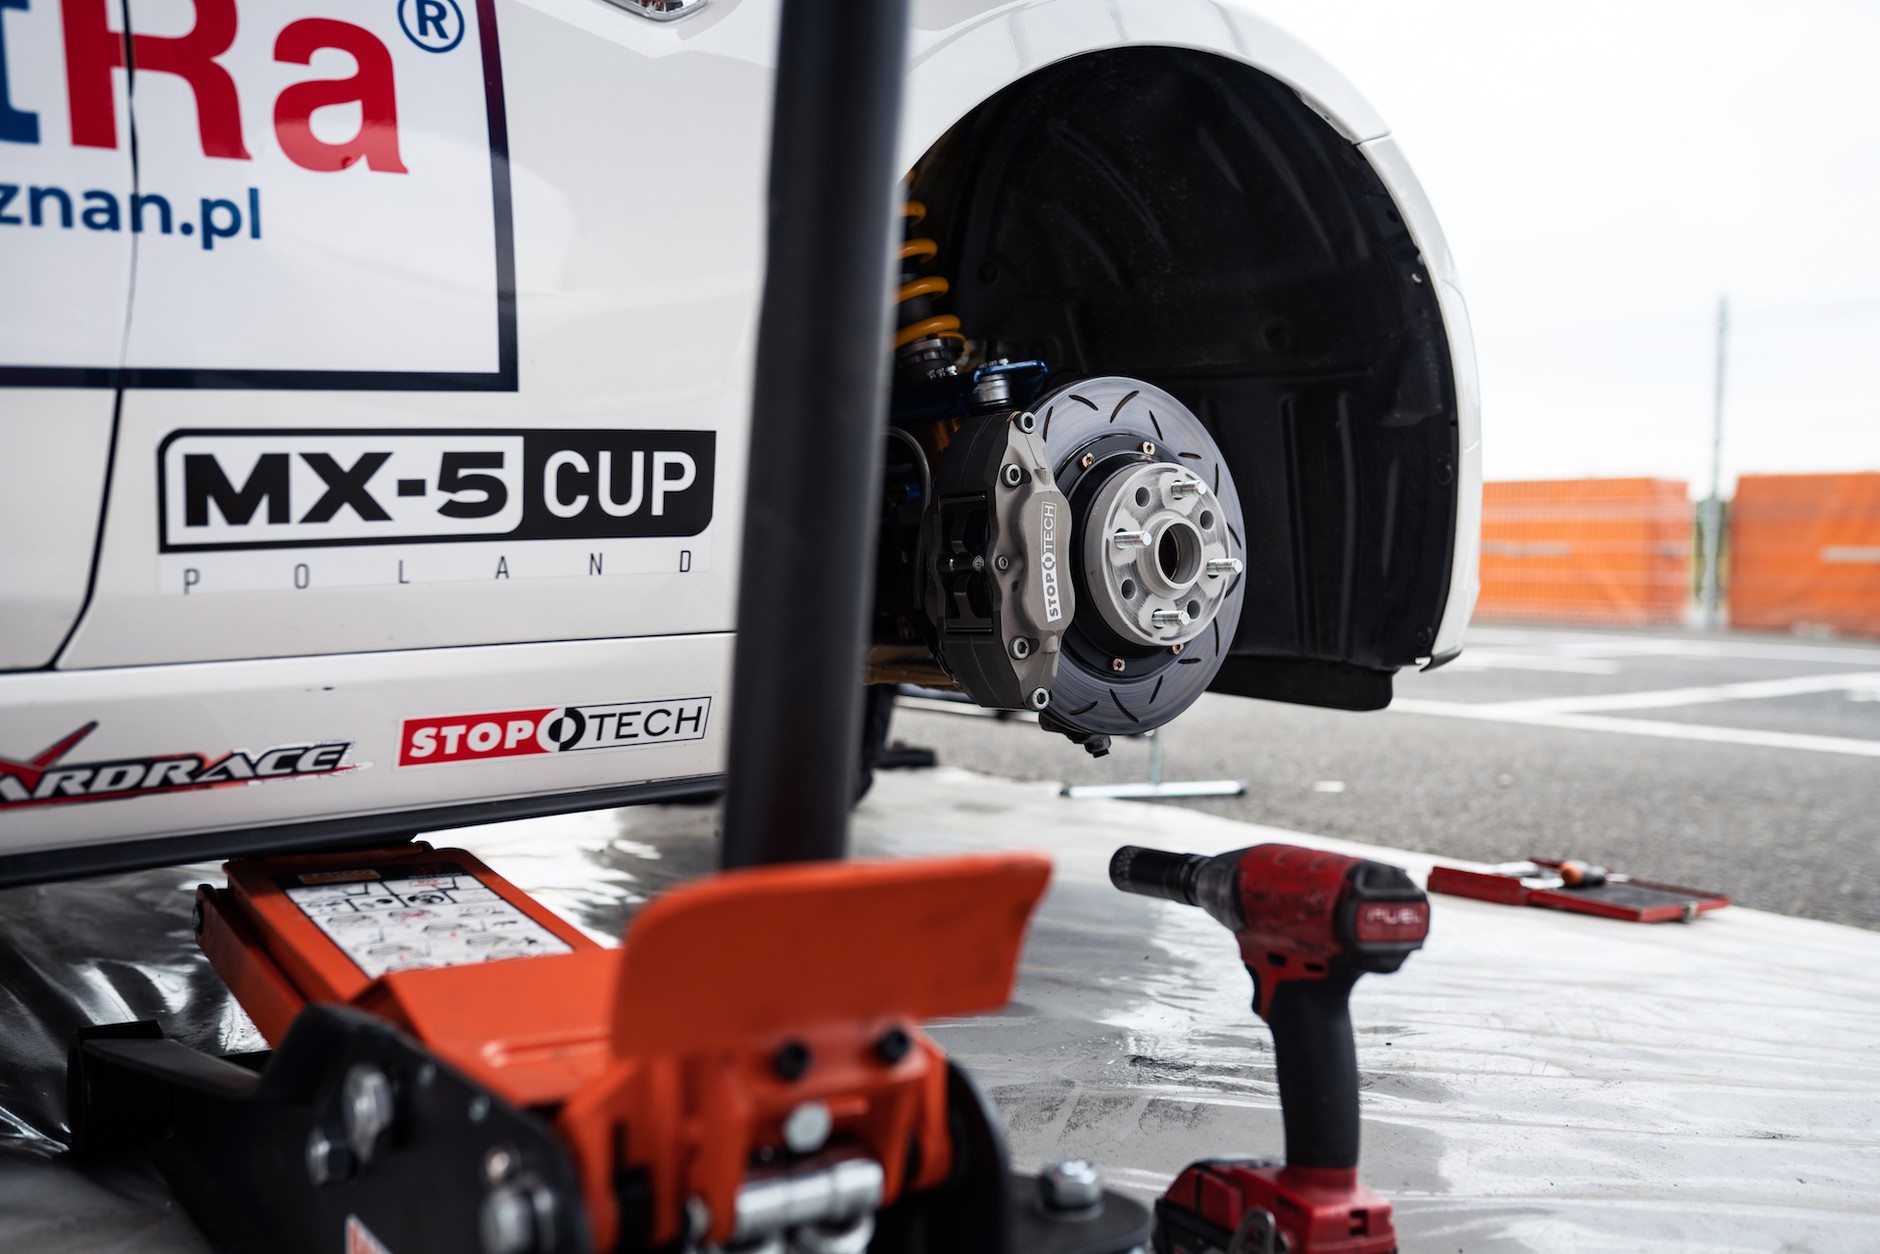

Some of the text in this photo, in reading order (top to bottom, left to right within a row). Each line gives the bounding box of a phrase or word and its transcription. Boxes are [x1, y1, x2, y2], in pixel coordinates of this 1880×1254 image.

[183, 449, 698, 528] MX-5 CUP
[183, 550, 692, 596] POLAND
[1366, 907, 1422, 925] FUEL
